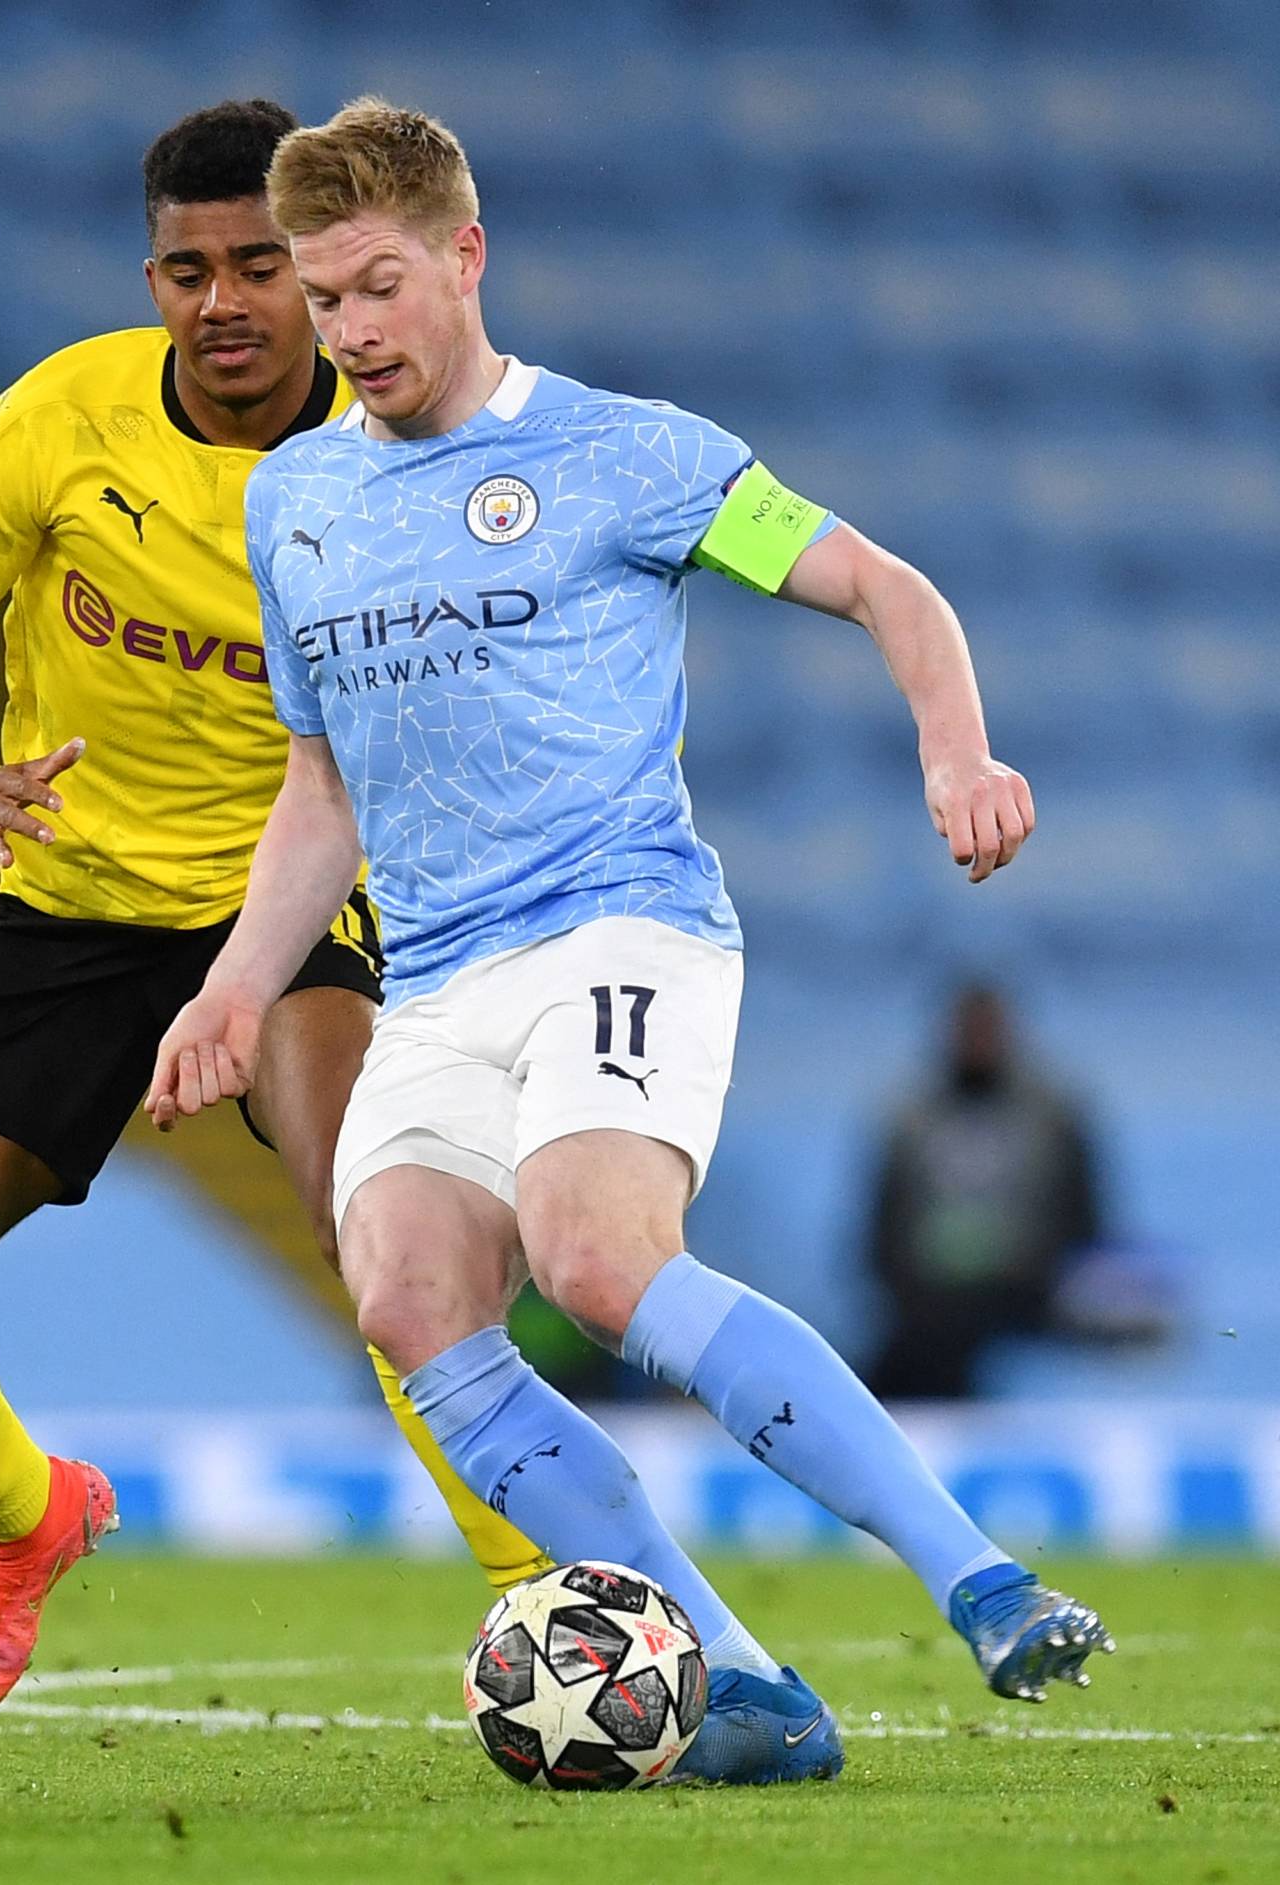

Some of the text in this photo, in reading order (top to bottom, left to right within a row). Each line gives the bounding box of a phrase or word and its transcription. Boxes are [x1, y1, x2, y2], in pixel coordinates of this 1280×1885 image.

[473, 481, 531, 504] MANCHESTER
[751, 484, 782, 524] NO TO
[490, 533, 512, 541] CITY
[296, 589, 539, 663] ETIHAD
[336, 646, 491, 697] AIRWAYS
[590, 985, 657, 1058] 17
